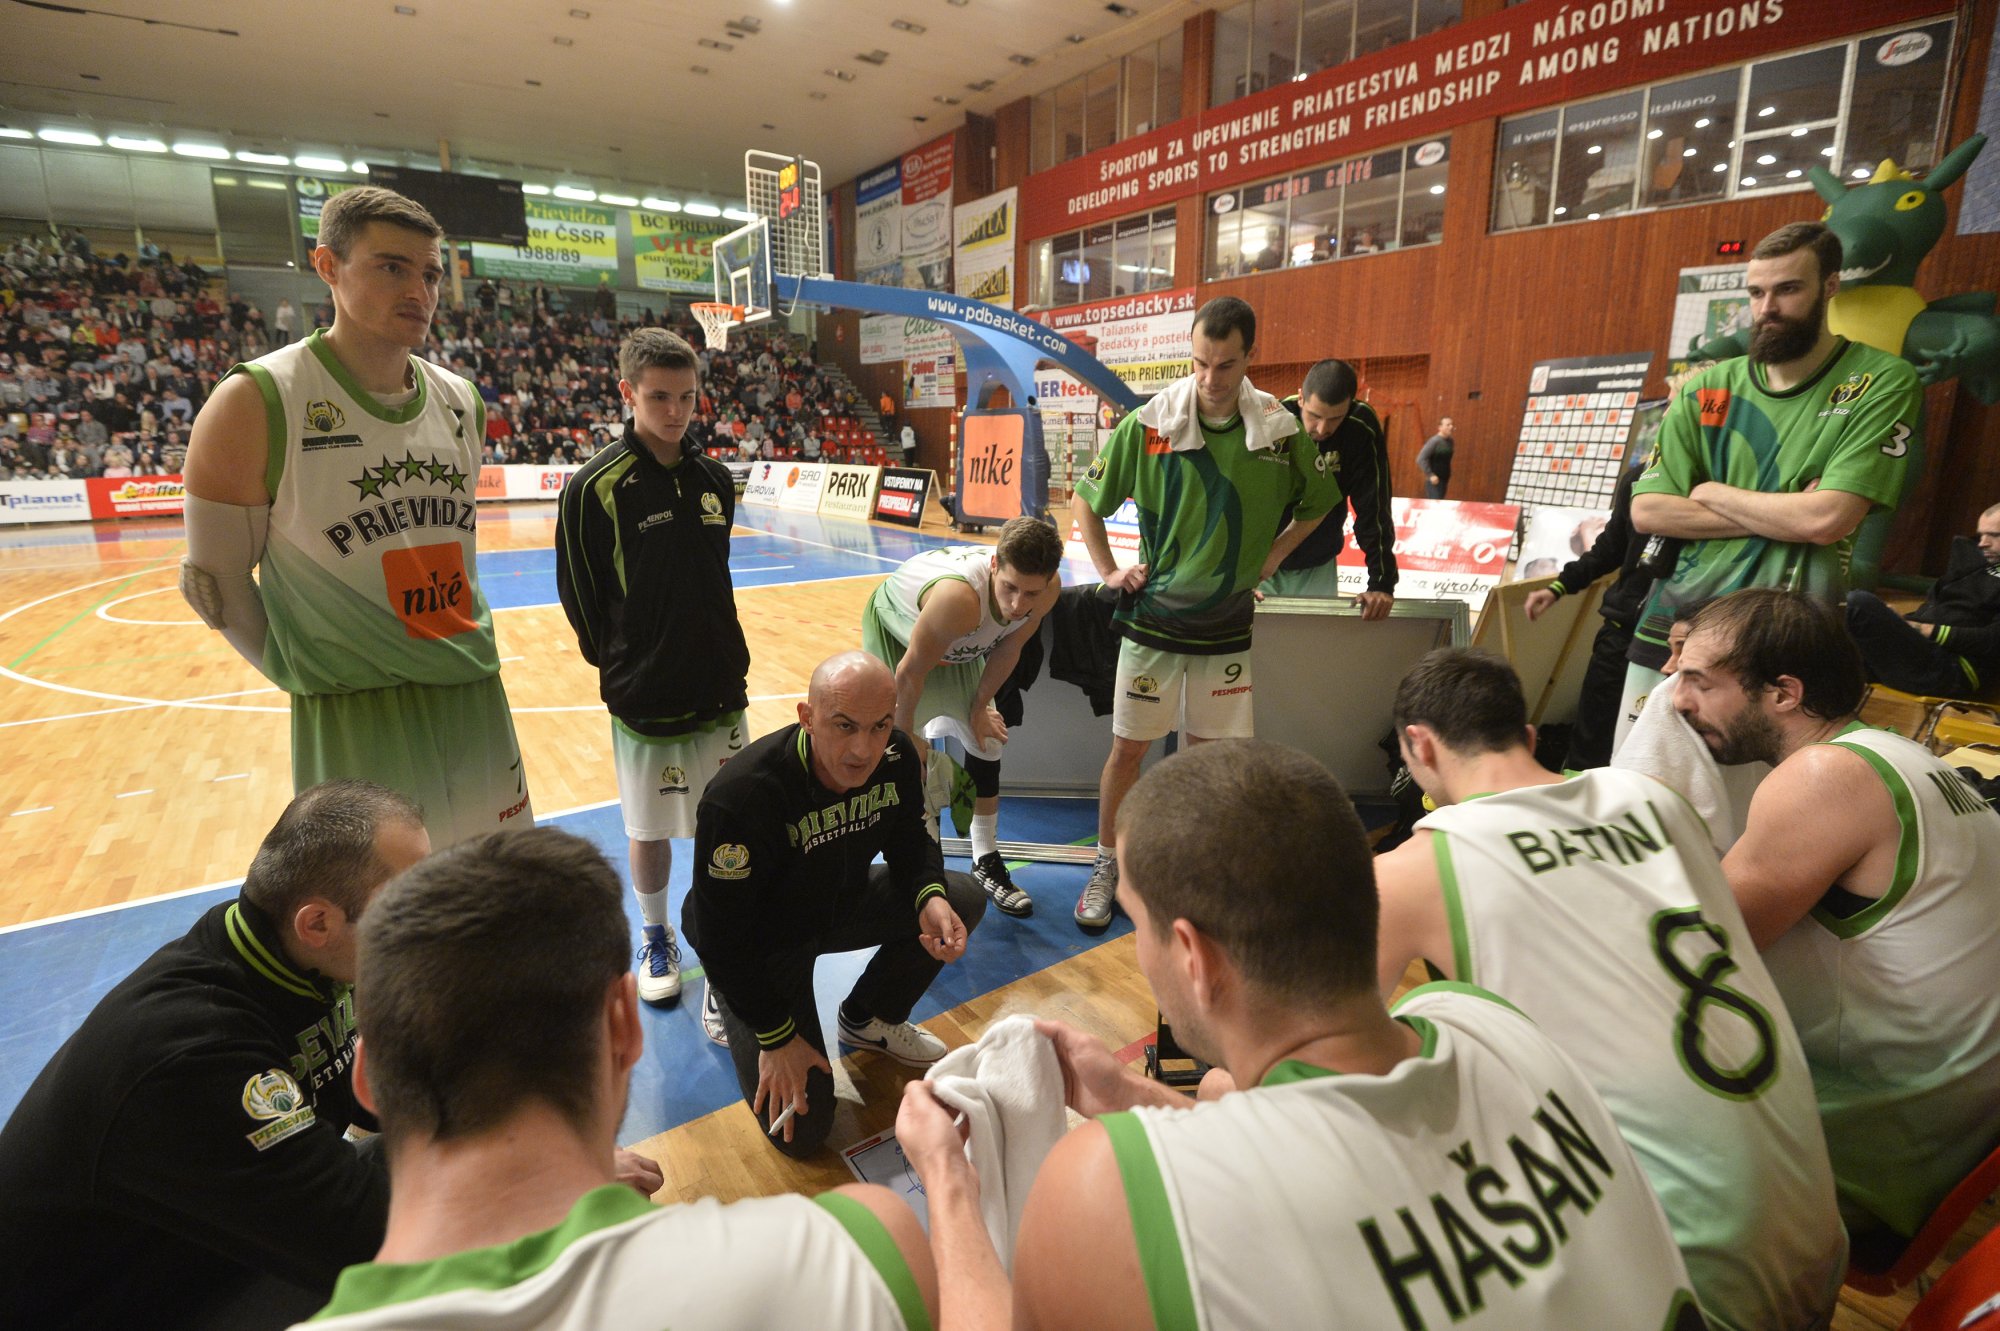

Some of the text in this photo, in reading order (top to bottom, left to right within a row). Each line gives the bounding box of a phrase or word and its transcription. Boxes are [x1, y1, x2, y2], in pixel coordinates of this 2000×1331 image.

[1068, 0, 1784, 215] DEVELOPING SPORTS TO STRENGTHEN FRIENDSHIP AMONG NATIONS
[1100, 147, 1158, 181] ŠPORTOM
[1167, 139, 1184, 160] ZA
[1192, 106, 1280, 151] UPEVNENIE
[1435, 31, 1511, 77] MEDZI
[1525, 128, 1557, 143] vero
[1567, 111, 1639, 133] espresso
[1650, 94, 1717, 115] italiano
[555, 224, 607, 245] ČSSR
[641, 214, 735, 236] BC PRIEVID
[1152, 218, 1177, 230] italian
[515, 245, 581, 264] 1988/89
[650, 232, 714, 257] víta
[665, 266, 701, 281] 1995
[1055, 293, 1195, 327] www.topsedacky.sk
[928, 297, 1067, 355] www.pdbasket.com
[1101, 322, 1148, 337] Talianske
[1100, 332, 1192, 351] sedačky a postele
[1159, 351, 1191, 361] Prievidza
[1139, 364, 1188, 381] PRIEVIDZA
[1702, 399, 1725, 414] iké
[1881, 420, 1912, 458] 3
[800, 470, 821, 481] SAD
[969, 444, 1014, 486] niké
[746, 485, 776, 496] EUROVIA
[828, 471, 870, 499] PARK
[824, 500, 867, 513] restaurant
[402, 570, 463, 616] niké
[1433, 578, 1490, 598] výroba
[1224, 663, 1242, 684] 9
[1649, 904, 1781, 1101] 8
[1357, 1088, 1615, 1331] HAŠAN
